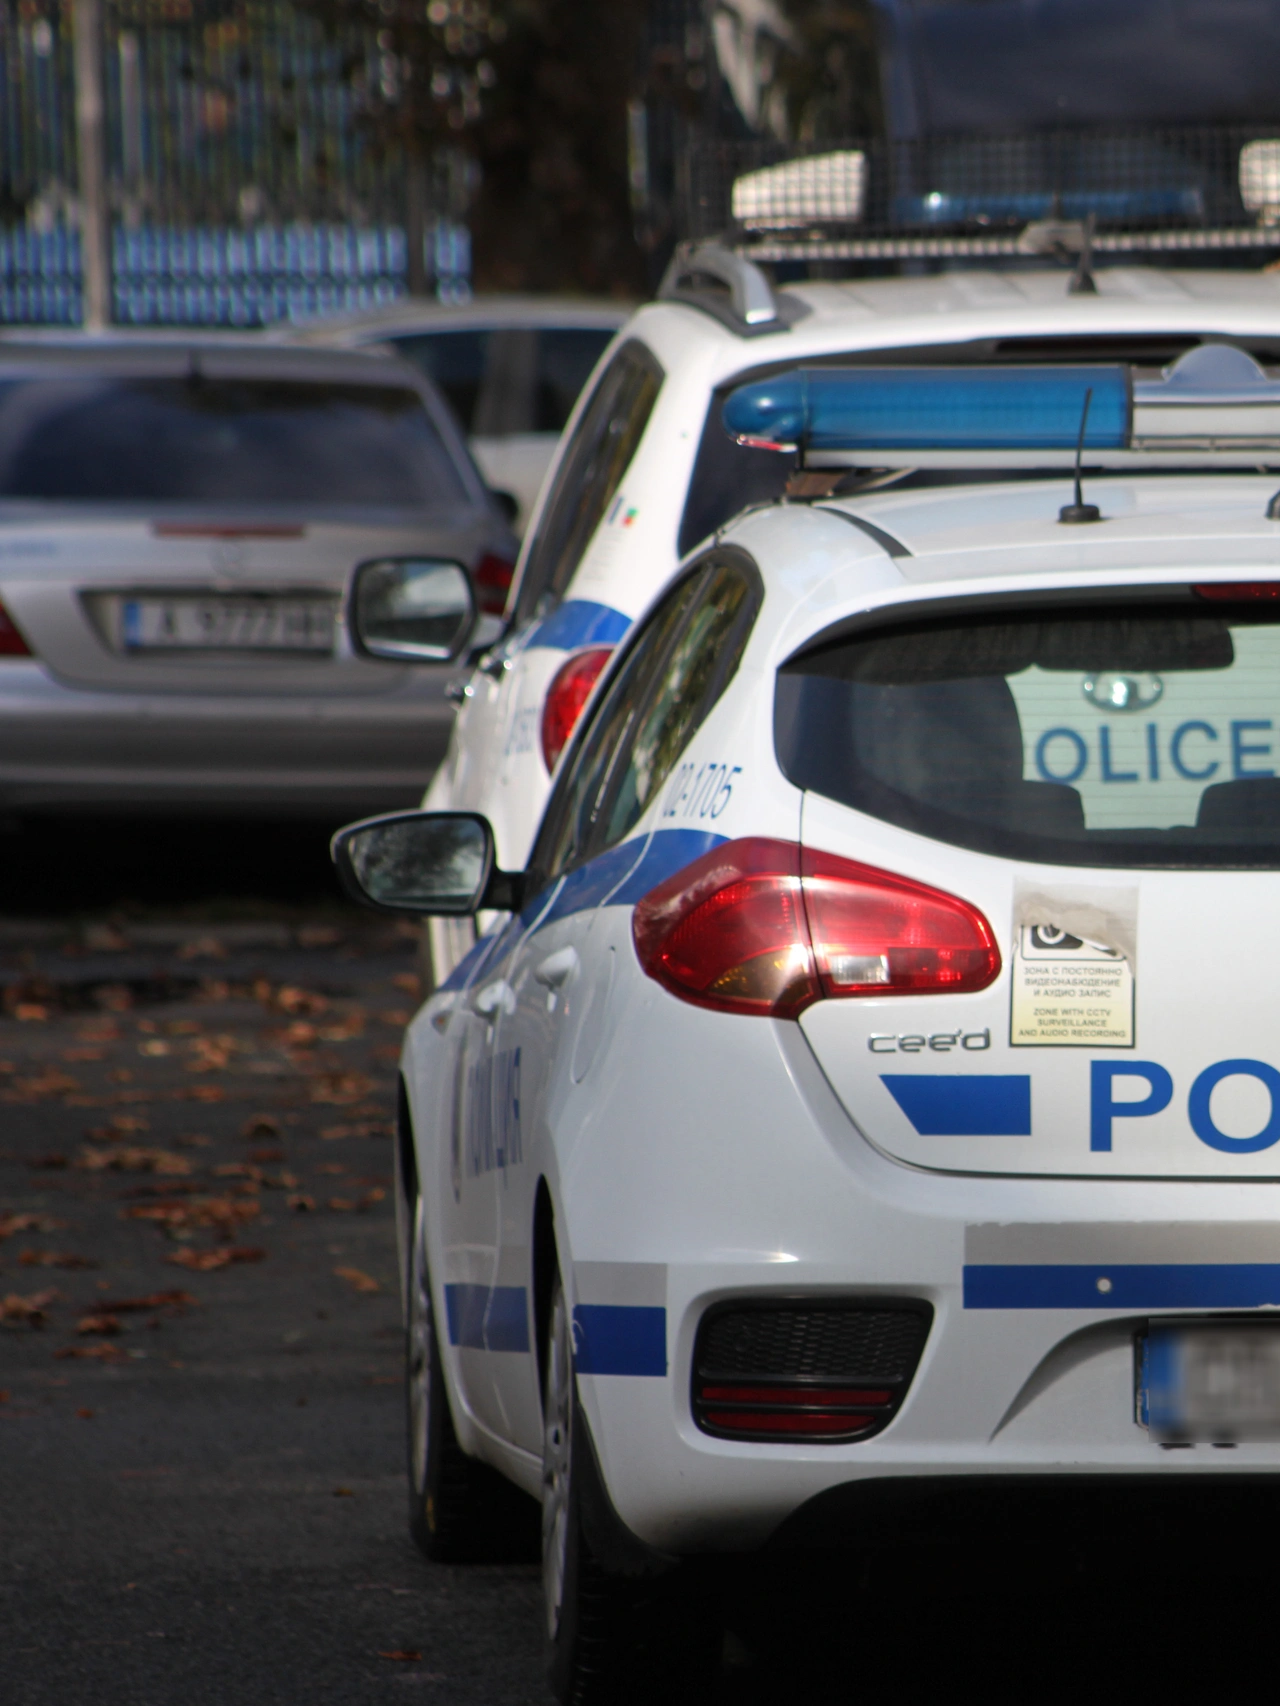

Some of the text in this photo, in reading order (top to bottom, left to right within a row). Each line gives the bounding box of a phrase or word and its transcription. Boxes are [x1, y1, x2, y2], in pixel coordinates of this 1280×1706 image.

[1034, 719, 1277, 786] OLICE
[1024, 966, 1050, 976] ЗОНА
[1061, 967, 1123, 977] ПОСТОЯННО
[1033, 988, 1112, 998] И АУДИО ЗАПИС
[1033, 1007, 1112, 1017] ZONE WITH CCTV
[1037, 1018, 1107, 1028] SURVEILLANCE
[1018, 1029, 1127, 1038] AND AUDIO RECORDING
[867, 1027, 991, 1053] cee'd
